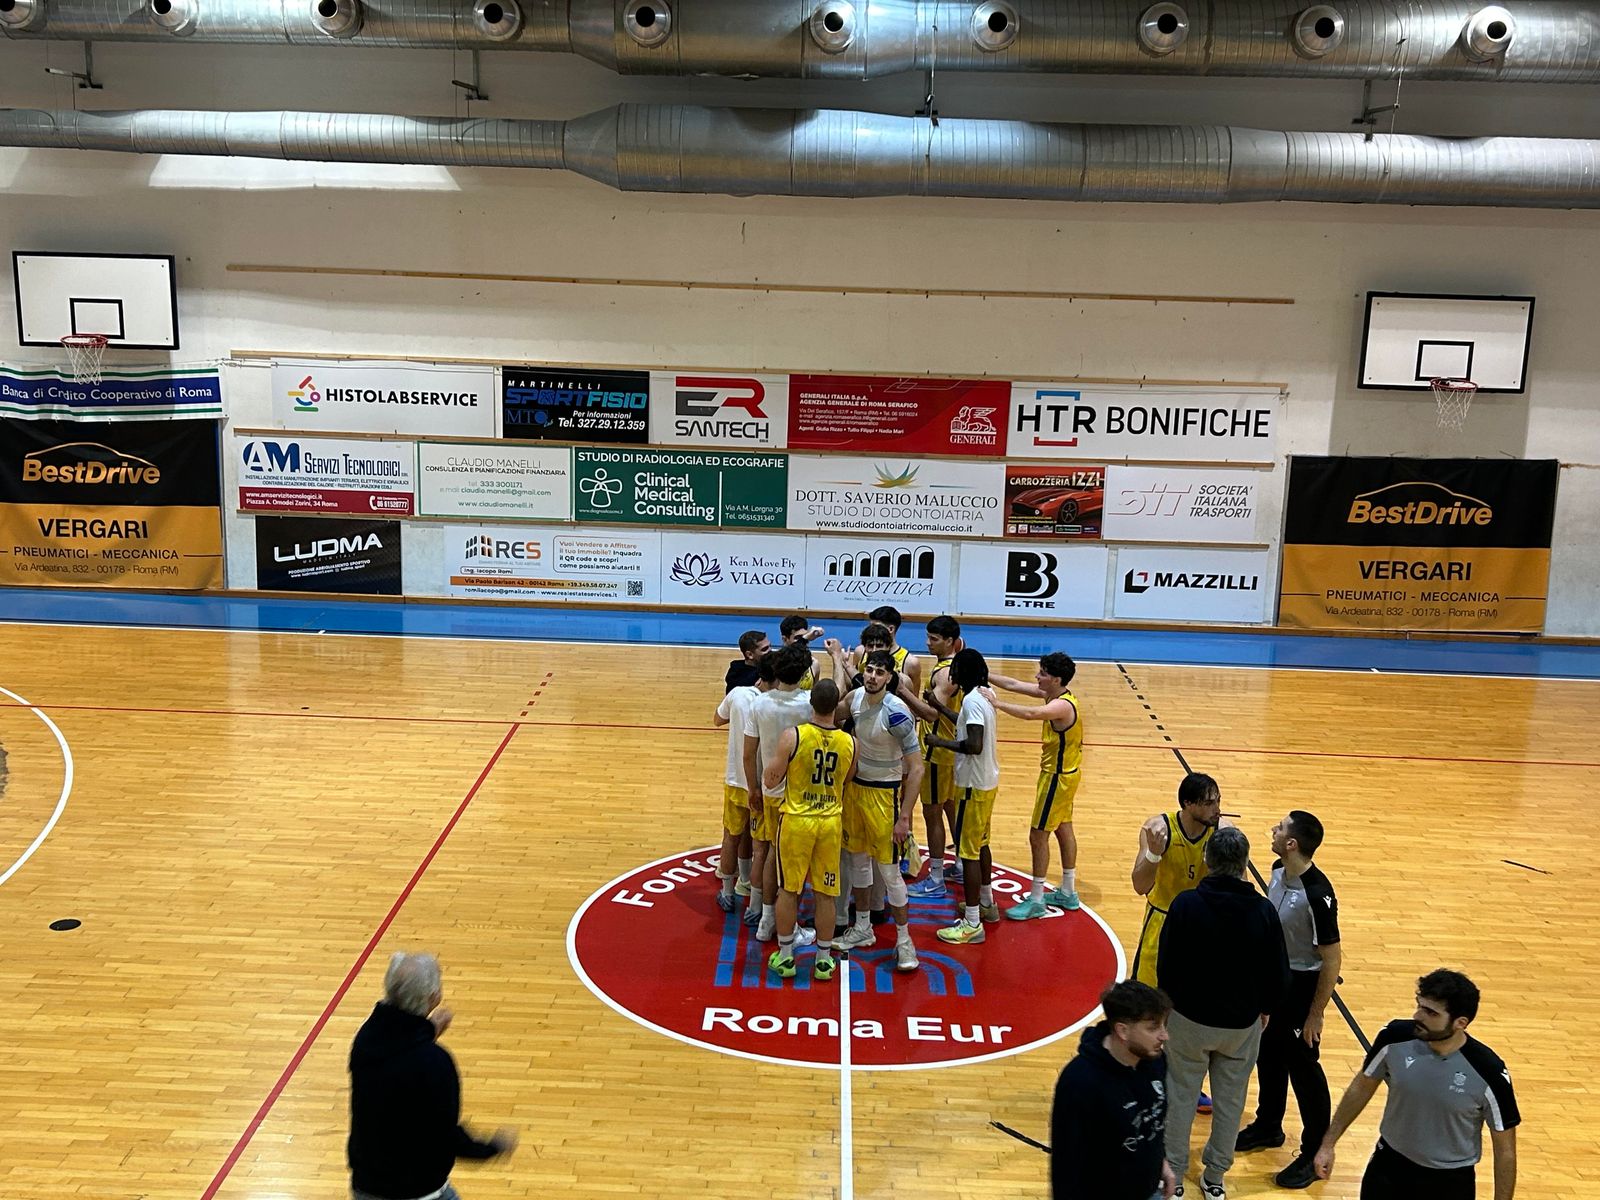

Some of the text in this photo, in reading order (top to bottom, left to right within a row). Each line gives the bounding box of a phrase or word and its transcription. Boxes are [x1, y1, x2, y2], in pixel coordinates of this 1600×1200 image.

[508, 380, 601, 390] MARTINELLI
[2, 385, 212, 402] Banca di Crdito Cooperativo di Roma
[326, 388, 478, 407] HISTOLABSERVICE
[504, 388, 648, 410] SPORTFISIO
[573, 410, 585, 419] Per
[1016, 404, 1271, 438] HTR BONIFICHE
[558, 418, 575, 428] Tel.
[577, 419, 646, 431] 327.29.12.359
[675, 420, 769, 439] SANTECH
[950, 435, 996, 446] GENERALI
[447, 457, 541, 469] CLAUDIO MANELLI
[578, 452, 784, 468] STUDIO DI RADIOLOGIA ED ECOGRAFIE
[22, 459, 161, 485] BestDrive
[425, 465, 469, 473] CONSULENZA
[475, 467, 525, 475] PIANIFICAZIONE
[526, 468, 566, 476] FINANZIARIA
[634, 472, 690, 488] Clinical
[1010, 472, 1100, 487] CARROZZERIA IZZI
[461, 487, 552, 496] claudio.manelli@gmail.com
[634, 487, 694, 502] Medical
[1199, 485, 1253, 496] SOCIETA'
[796, 490, 998, 508] DOTT. SAVERIO MALUCCIO
[1194, 496, 1247, 507] ITALIANA
[634, 501, 715, 521] Consulting
[751, 505, 773, 514] Lorgna
[775, 506, 783, 514] 30
[808, 504, 984, 521] STUDIO DI ODONTOIATRIA
[1190, 507, 1252, 518] TRASPORTI
[1347, 500, 1493, 525] BestDrive
[38, 518, 148, 539] VERGARI
[816, 520, 973, 533] www.studiodontoiatricomaluccio.it
[13, 546, 179, 560] PNEUMATICI MECCANICA
[274, 533, 383, 563] LUDMA
[495, 540, 541, 560] RES
[15, 563, 29, 572] Via
[73, 563, 89, 573] 832
[97, 564, 126, 574] 00178
[133, 565, 159, 575] Roma
[160, 565, 179, 575] (RM)
[729, 556, 797, 570] Ken Move Fly
[1359, 560, 1472, 581] VERGARI
[730, 572, 795, 586] VIAGGI
[1154, 572, 1258, 590] MAZZILLI
[823, 579, 935, 597] EUROTTICA
[1326, 590, 1500, 603] PNEUMATICI MECCANICA
[1004, 600, 1056, 609] B.TRE
[1325, 607, 1498, 619] Via Ardeatina, 832 00178 Roma (RM)
[811, 749, 838, 786] 32
[824, 871, 836, 886] 32
[1188, 864, 1195, 880] 5
[701, 1005, 1013, 1044] Roma Eur
